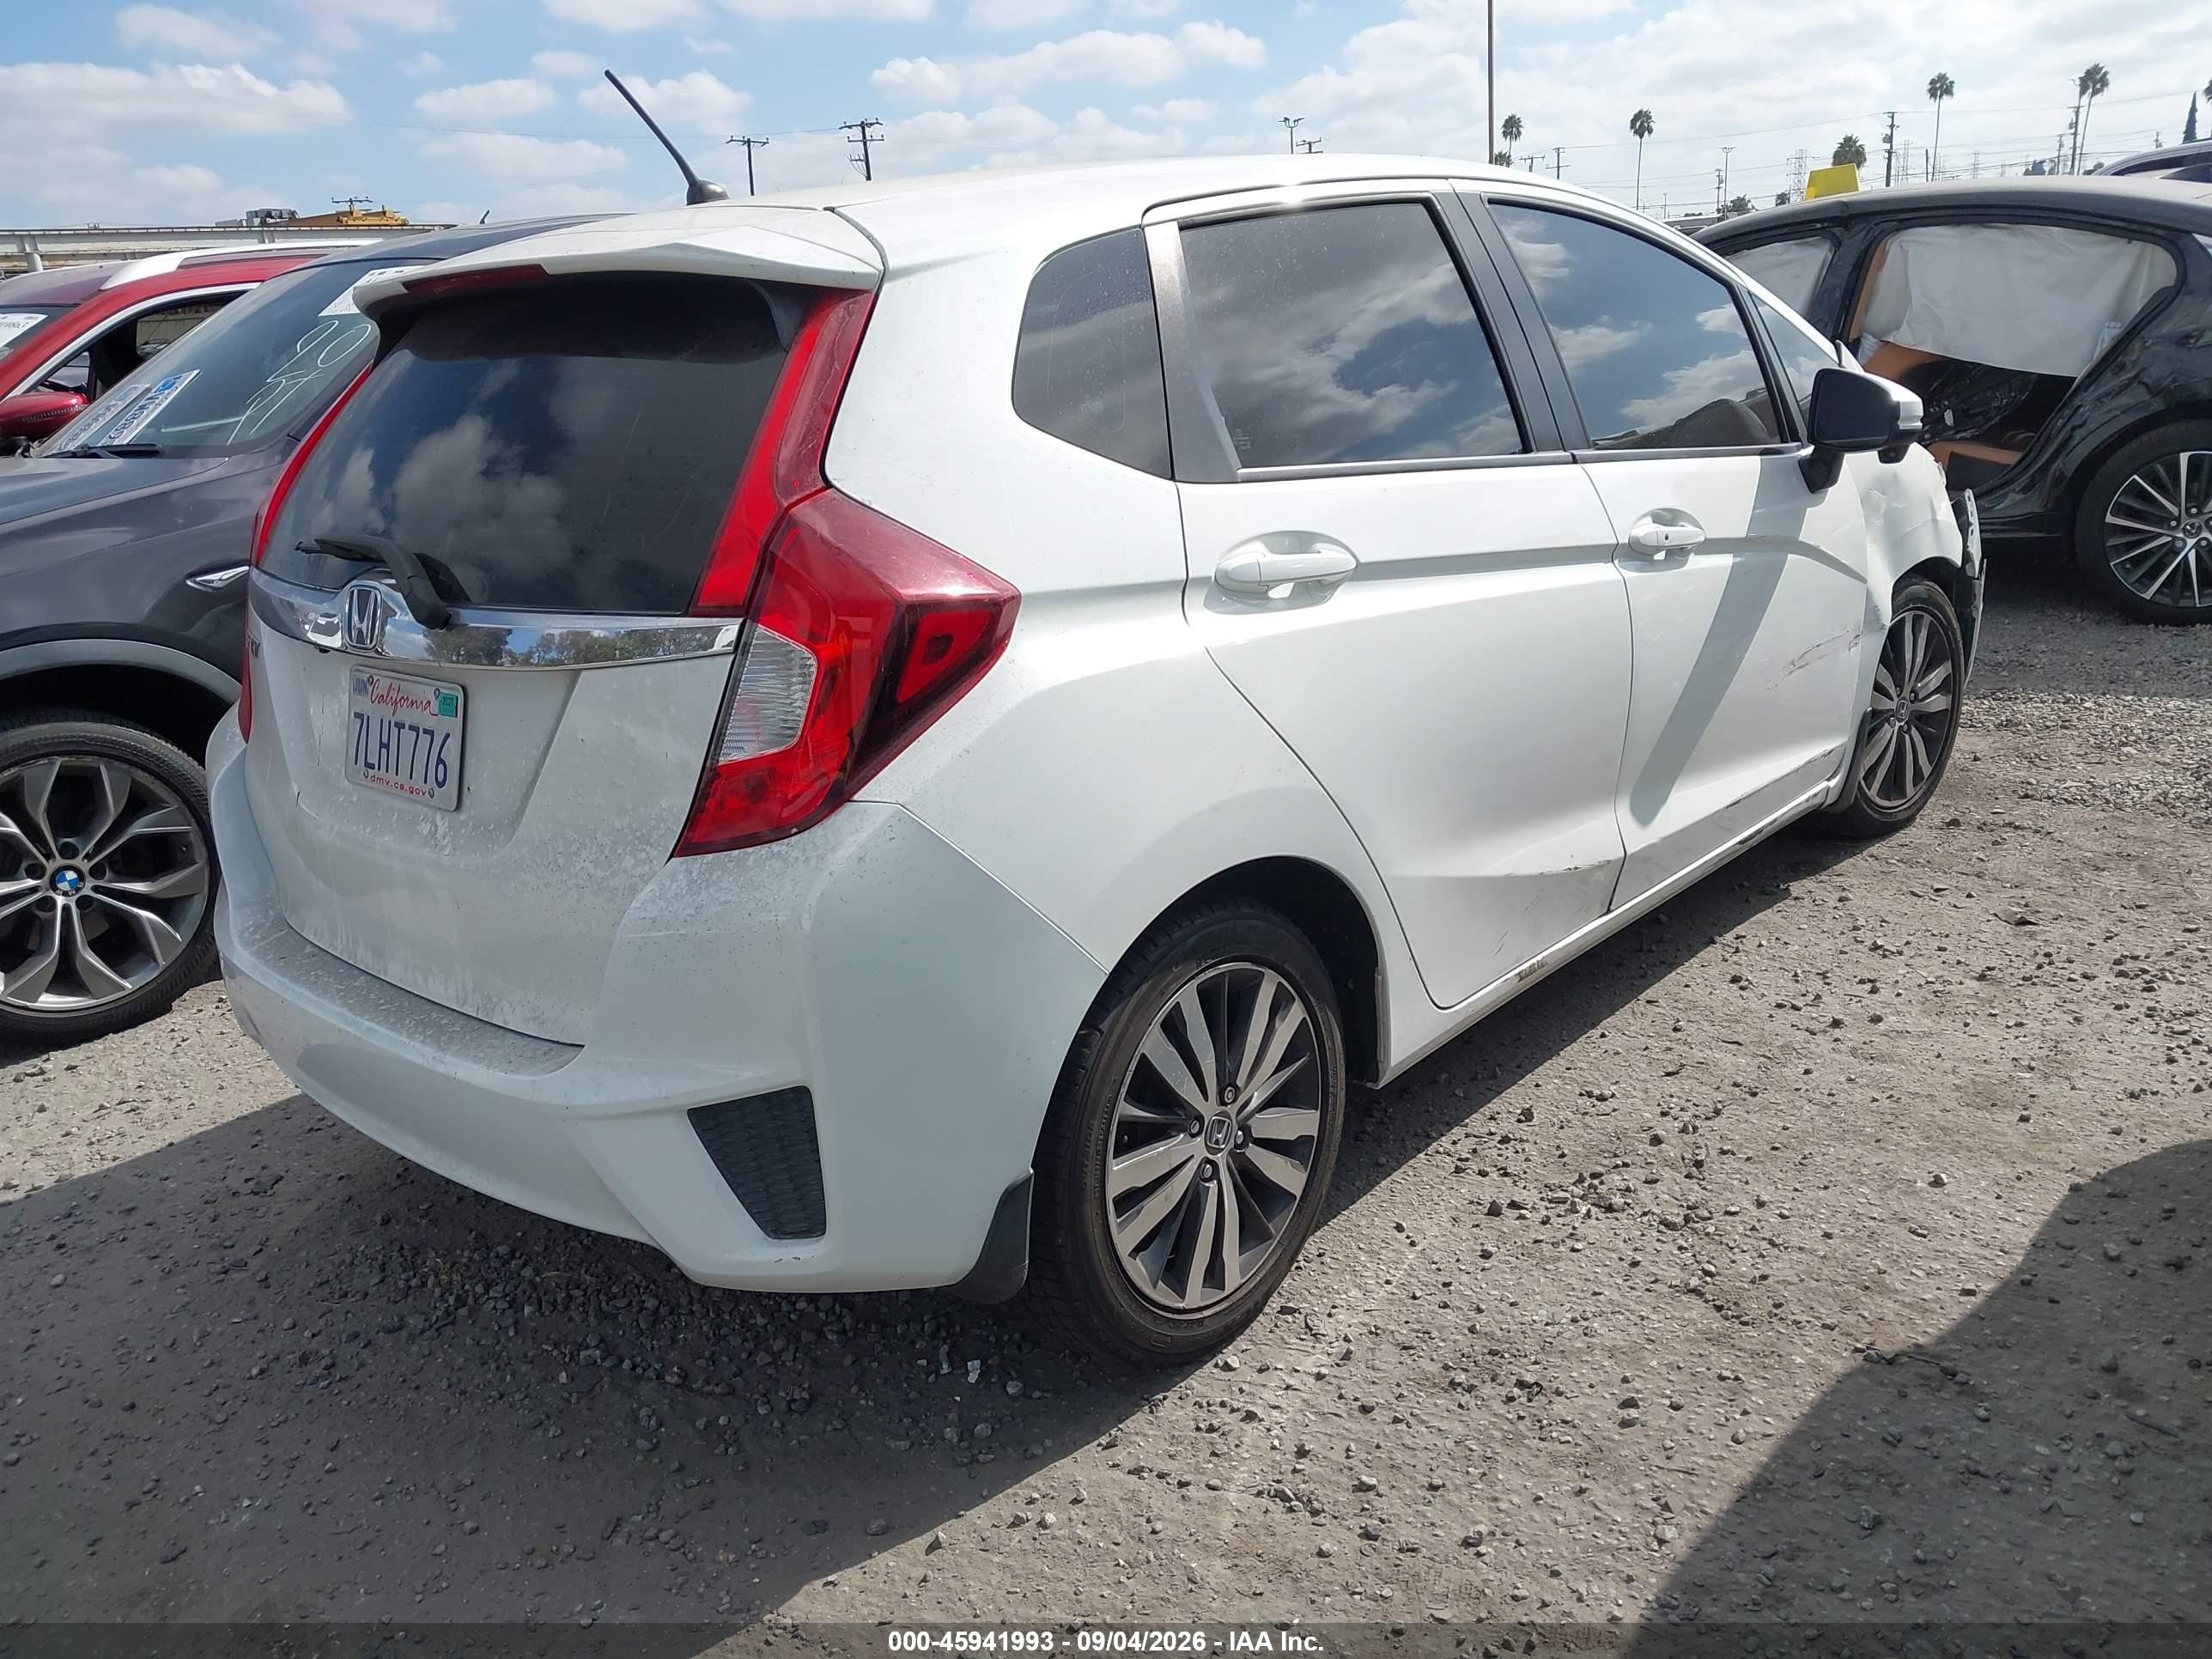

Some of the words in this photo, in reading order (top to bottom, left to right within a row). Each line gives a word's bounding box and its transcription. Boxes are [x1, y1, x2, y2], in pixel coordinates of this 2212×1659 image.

[370, 678, 439, 717] California
[354, 711, 451, 788] 7LHT776
[370, 775, 427, 797] dmv.ca.gov
